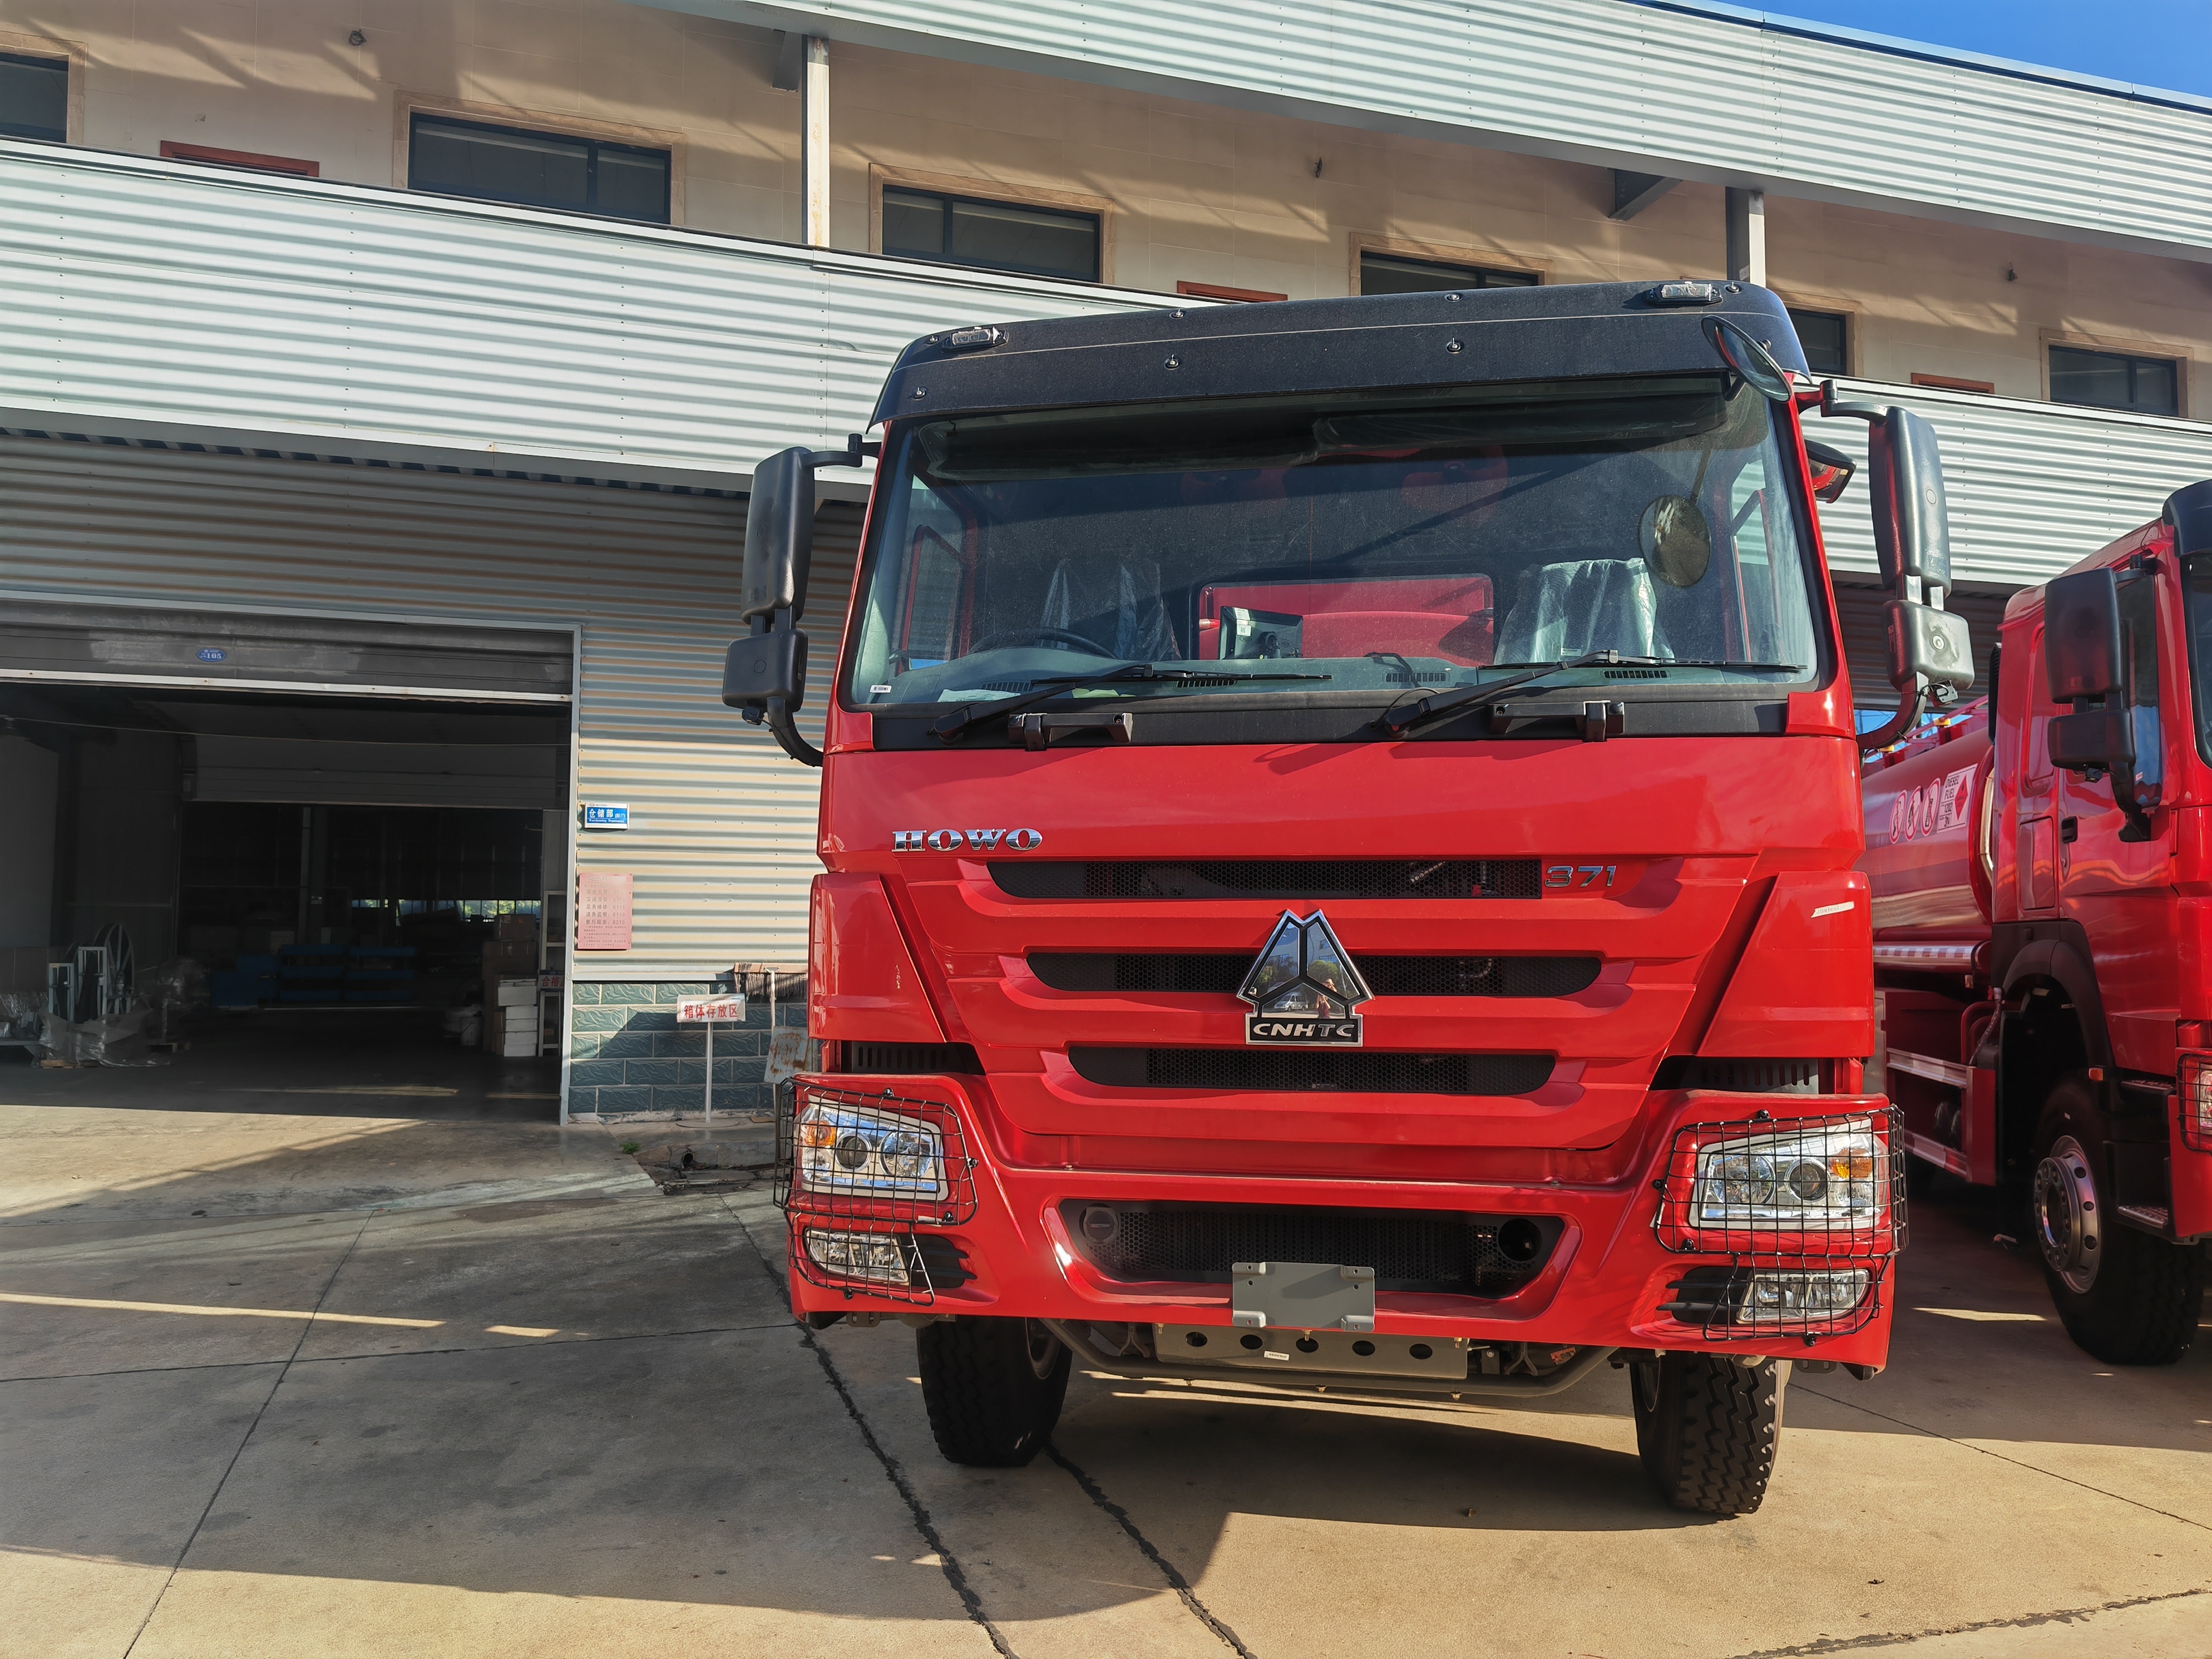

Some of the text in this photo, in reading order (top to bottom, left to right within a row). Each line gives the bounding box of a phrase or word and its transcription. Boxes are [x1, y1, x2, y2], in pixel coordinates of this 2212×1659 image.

[1945, 775, 1960, 788] DIESEL
[1944, 788, 1955, 800] FUEL
[589, 808, 613, 818] 仓储部
[1944, 801, 1953, 813] 1202
[891, 828, 1043, 852] HOWO
[1545, 866, 1616, 887] 371
[684, 1004, 738, 1019] 箱体存放区
[1252, 1023, 1355, 1037] CNHTC
